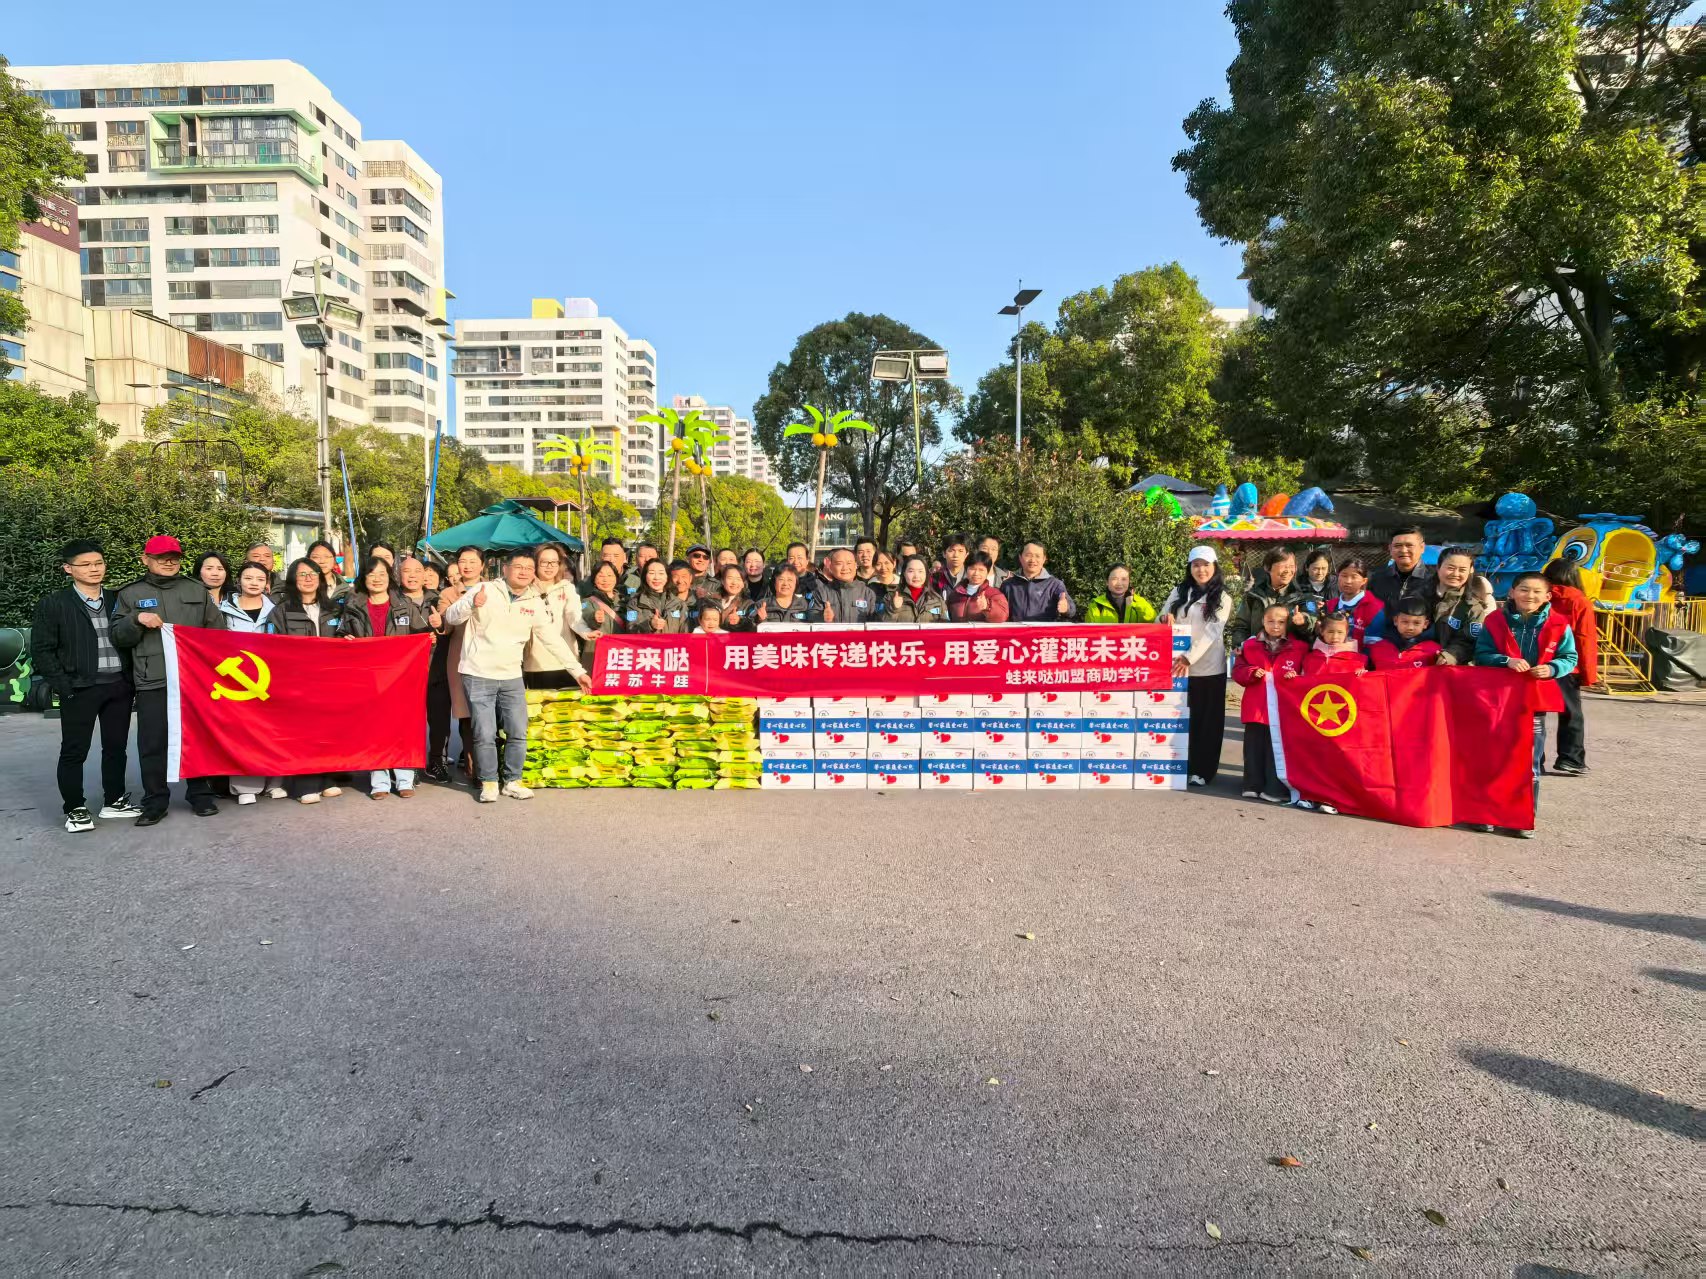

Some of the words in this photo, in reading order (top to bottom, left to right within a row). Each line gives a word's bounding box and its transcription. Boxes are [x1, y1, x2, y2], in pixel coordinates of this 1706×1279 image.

[605, 647, 690, 672] 蛙来哒
[723, 636, 1160, 670] 用美味传递快乐，用爱心灌溉未来。
[604, 673, 689, 688] 紫苏牛蛙
[1005, 667, 1150, 685] 蛙来哒加盟商助学行
